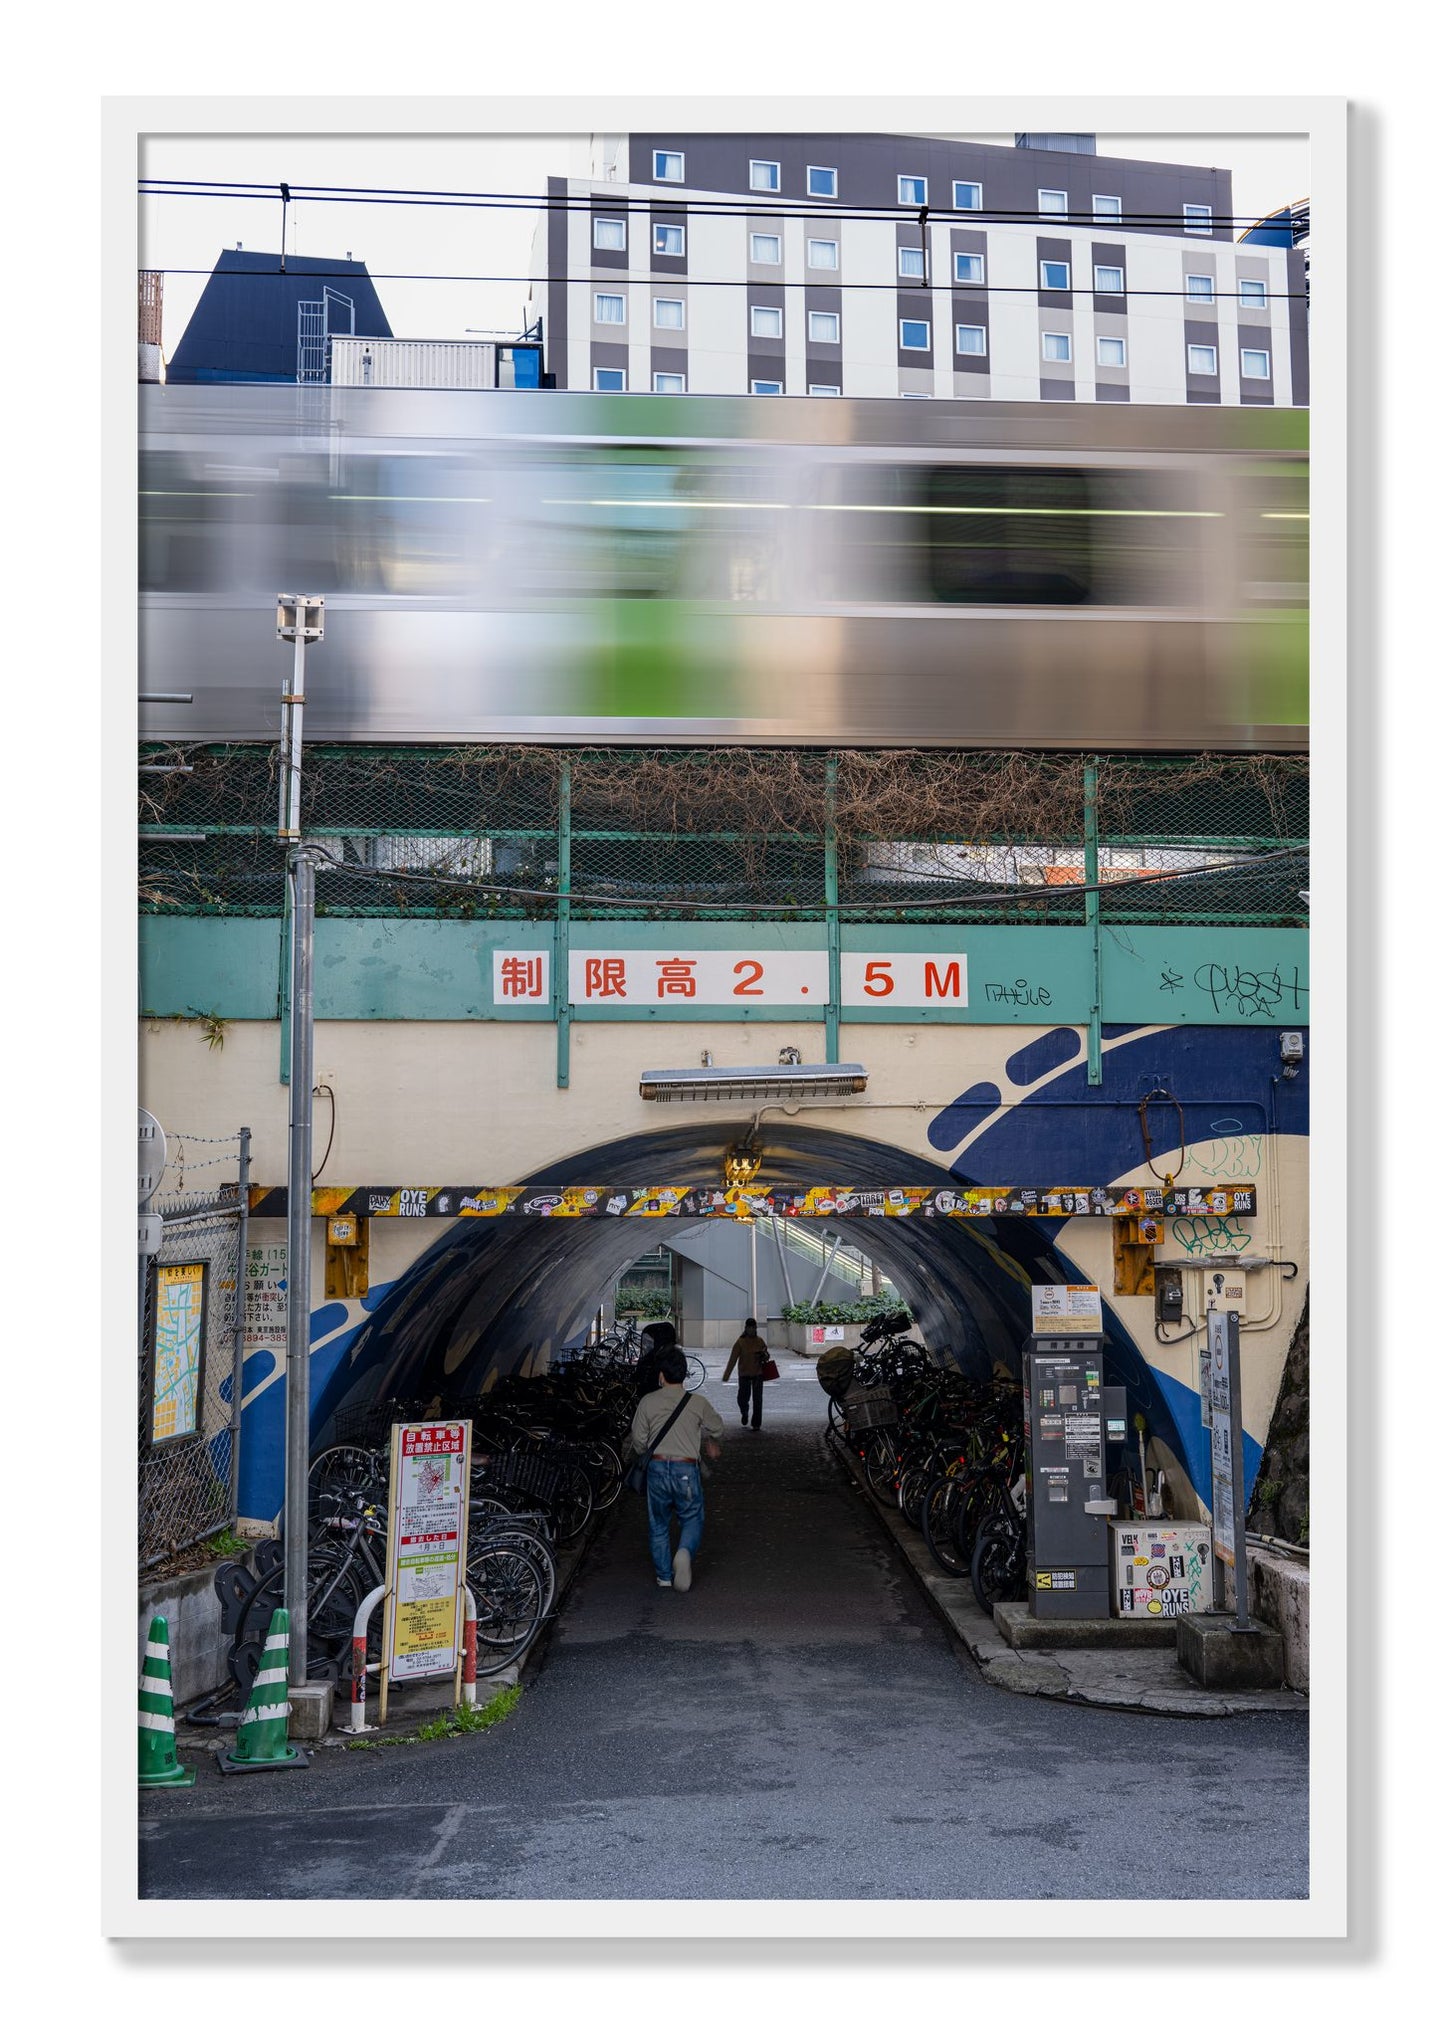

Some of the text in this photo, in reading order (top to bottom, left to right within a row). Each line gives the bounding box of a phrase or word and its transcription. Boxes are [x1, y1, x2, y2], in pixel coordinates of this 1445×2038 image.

[401, 1189, 428, 1204] OYE
[1234, 1192, 1251, 1201] OYE
[399, 1203, 427, 1217] RUNS
[1234, 1201, 1252, 1210] RUNS
[405, 1441, 460, 1454] 放置禁止区域
[1162, 1589, 1188, 1603] OYE
[1163, 1601, 1189, 1617] RUNS
